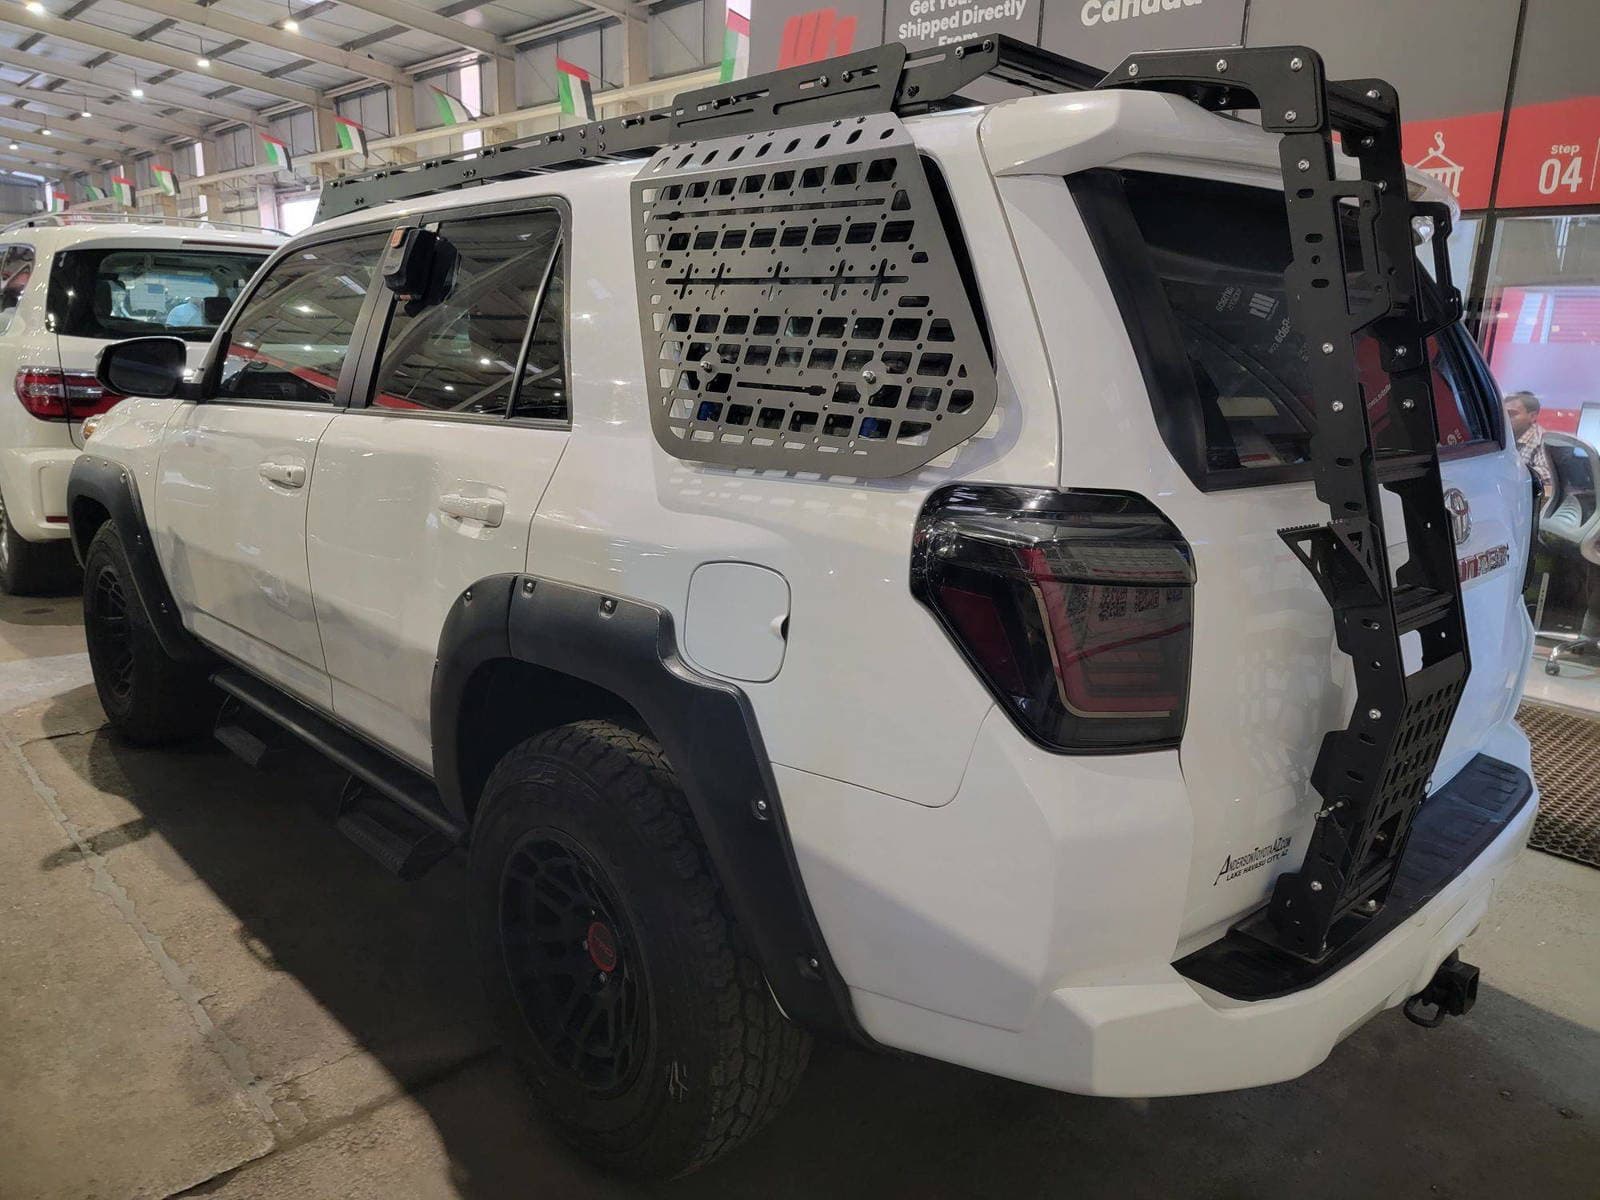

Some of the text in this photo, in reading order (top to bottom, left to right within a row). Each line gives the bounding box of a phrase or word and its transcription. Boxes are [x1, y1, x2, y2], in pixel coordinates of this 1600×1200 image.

[909, 0, 972, 16] Get Yo
[1080, 0, 1202, 26] Cana
[898, 0, 1027, 41] Shipped Directly
[1551, 144, 1580, 156] Step
[1538, 156, 1583, 195] 04
[1226, 869, 1242, 881] LAKE
